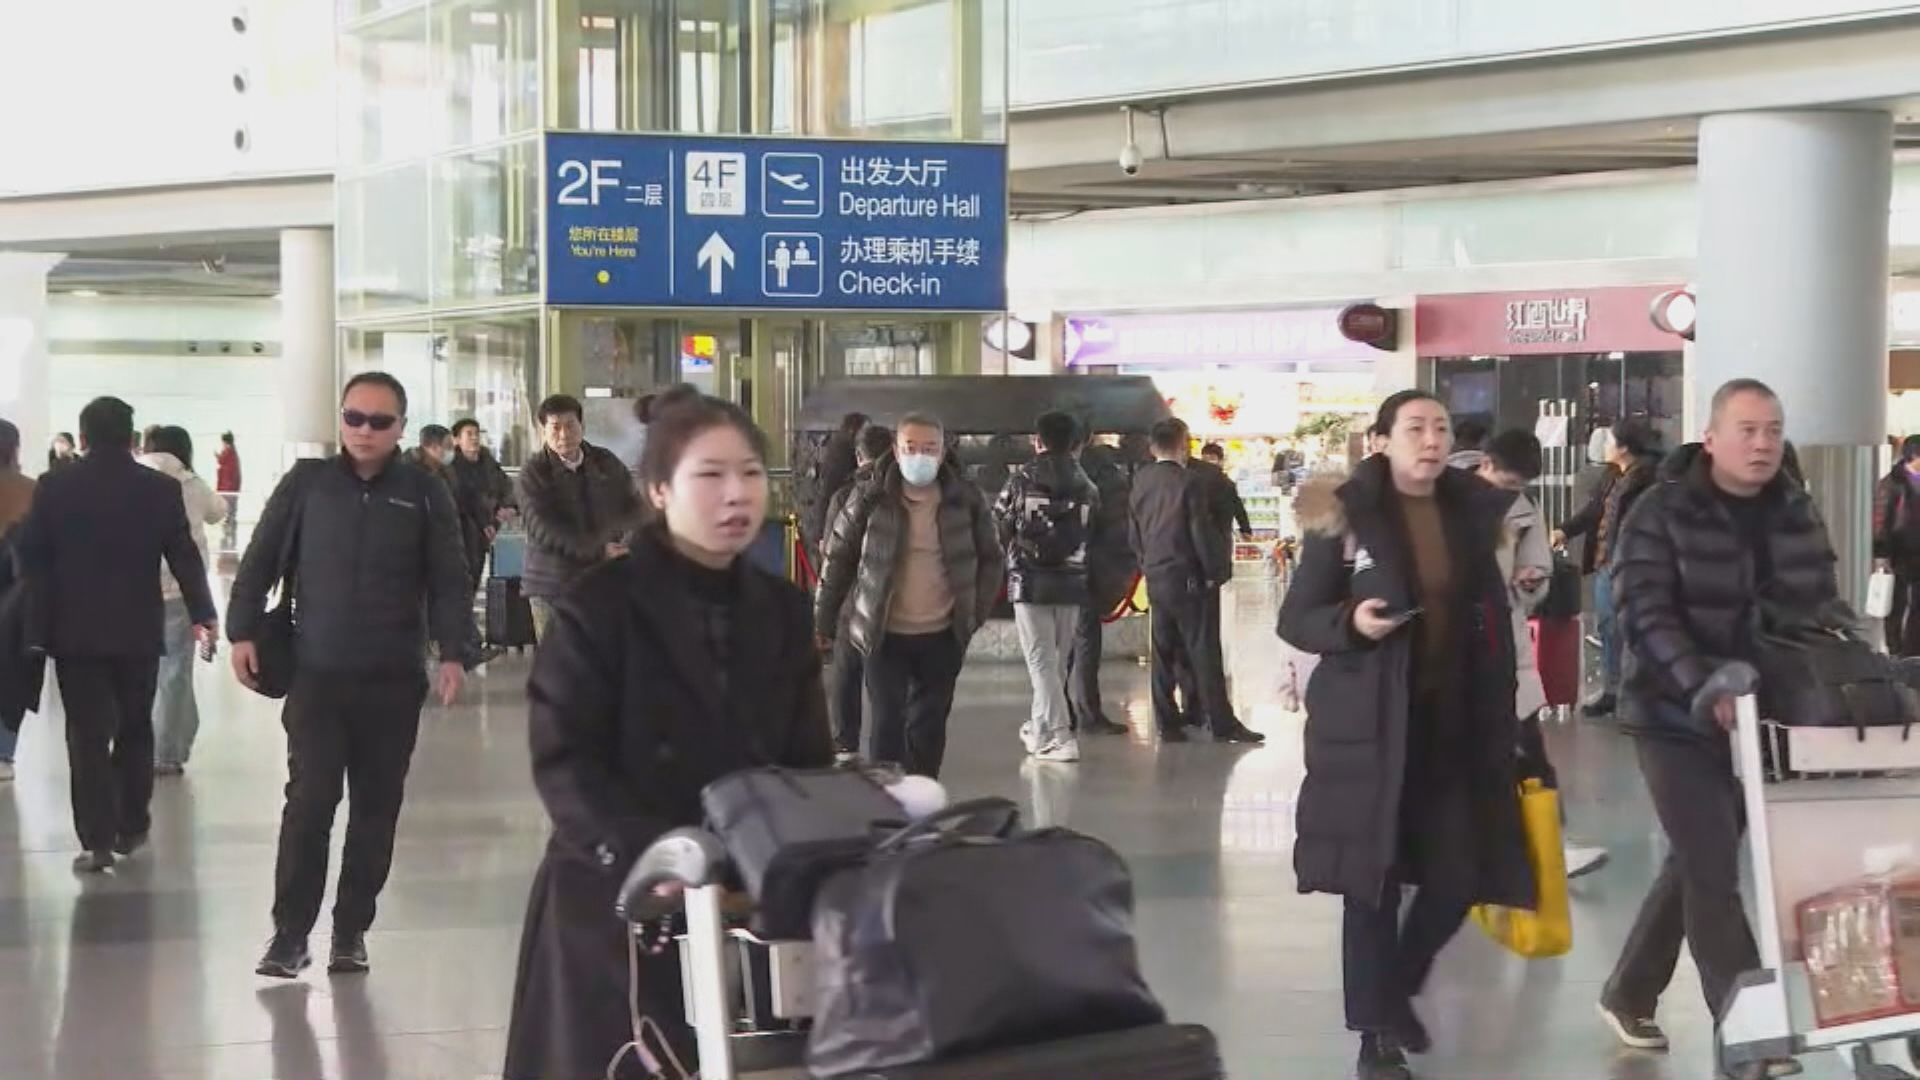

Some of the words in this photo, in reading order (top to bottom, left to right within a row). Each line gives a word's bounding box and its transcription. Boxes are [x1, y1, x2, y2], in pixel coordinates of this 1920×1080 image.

[557, 159, 622, 205] 2F
[624, 184, 663, 206] 二层
[692, 159, 738, 189] 4F
[840, 155, 948, 187] 出发大厅
[839, 191, 938, 221] Departure
[942, 193, 980, 217] Hall
[570, 244, 606, 257] You're
[608, 245, 637, 257] Here
[840, 235, 980, 265] 办理乘机手续
[838, 269, 941, 296] Check-in
